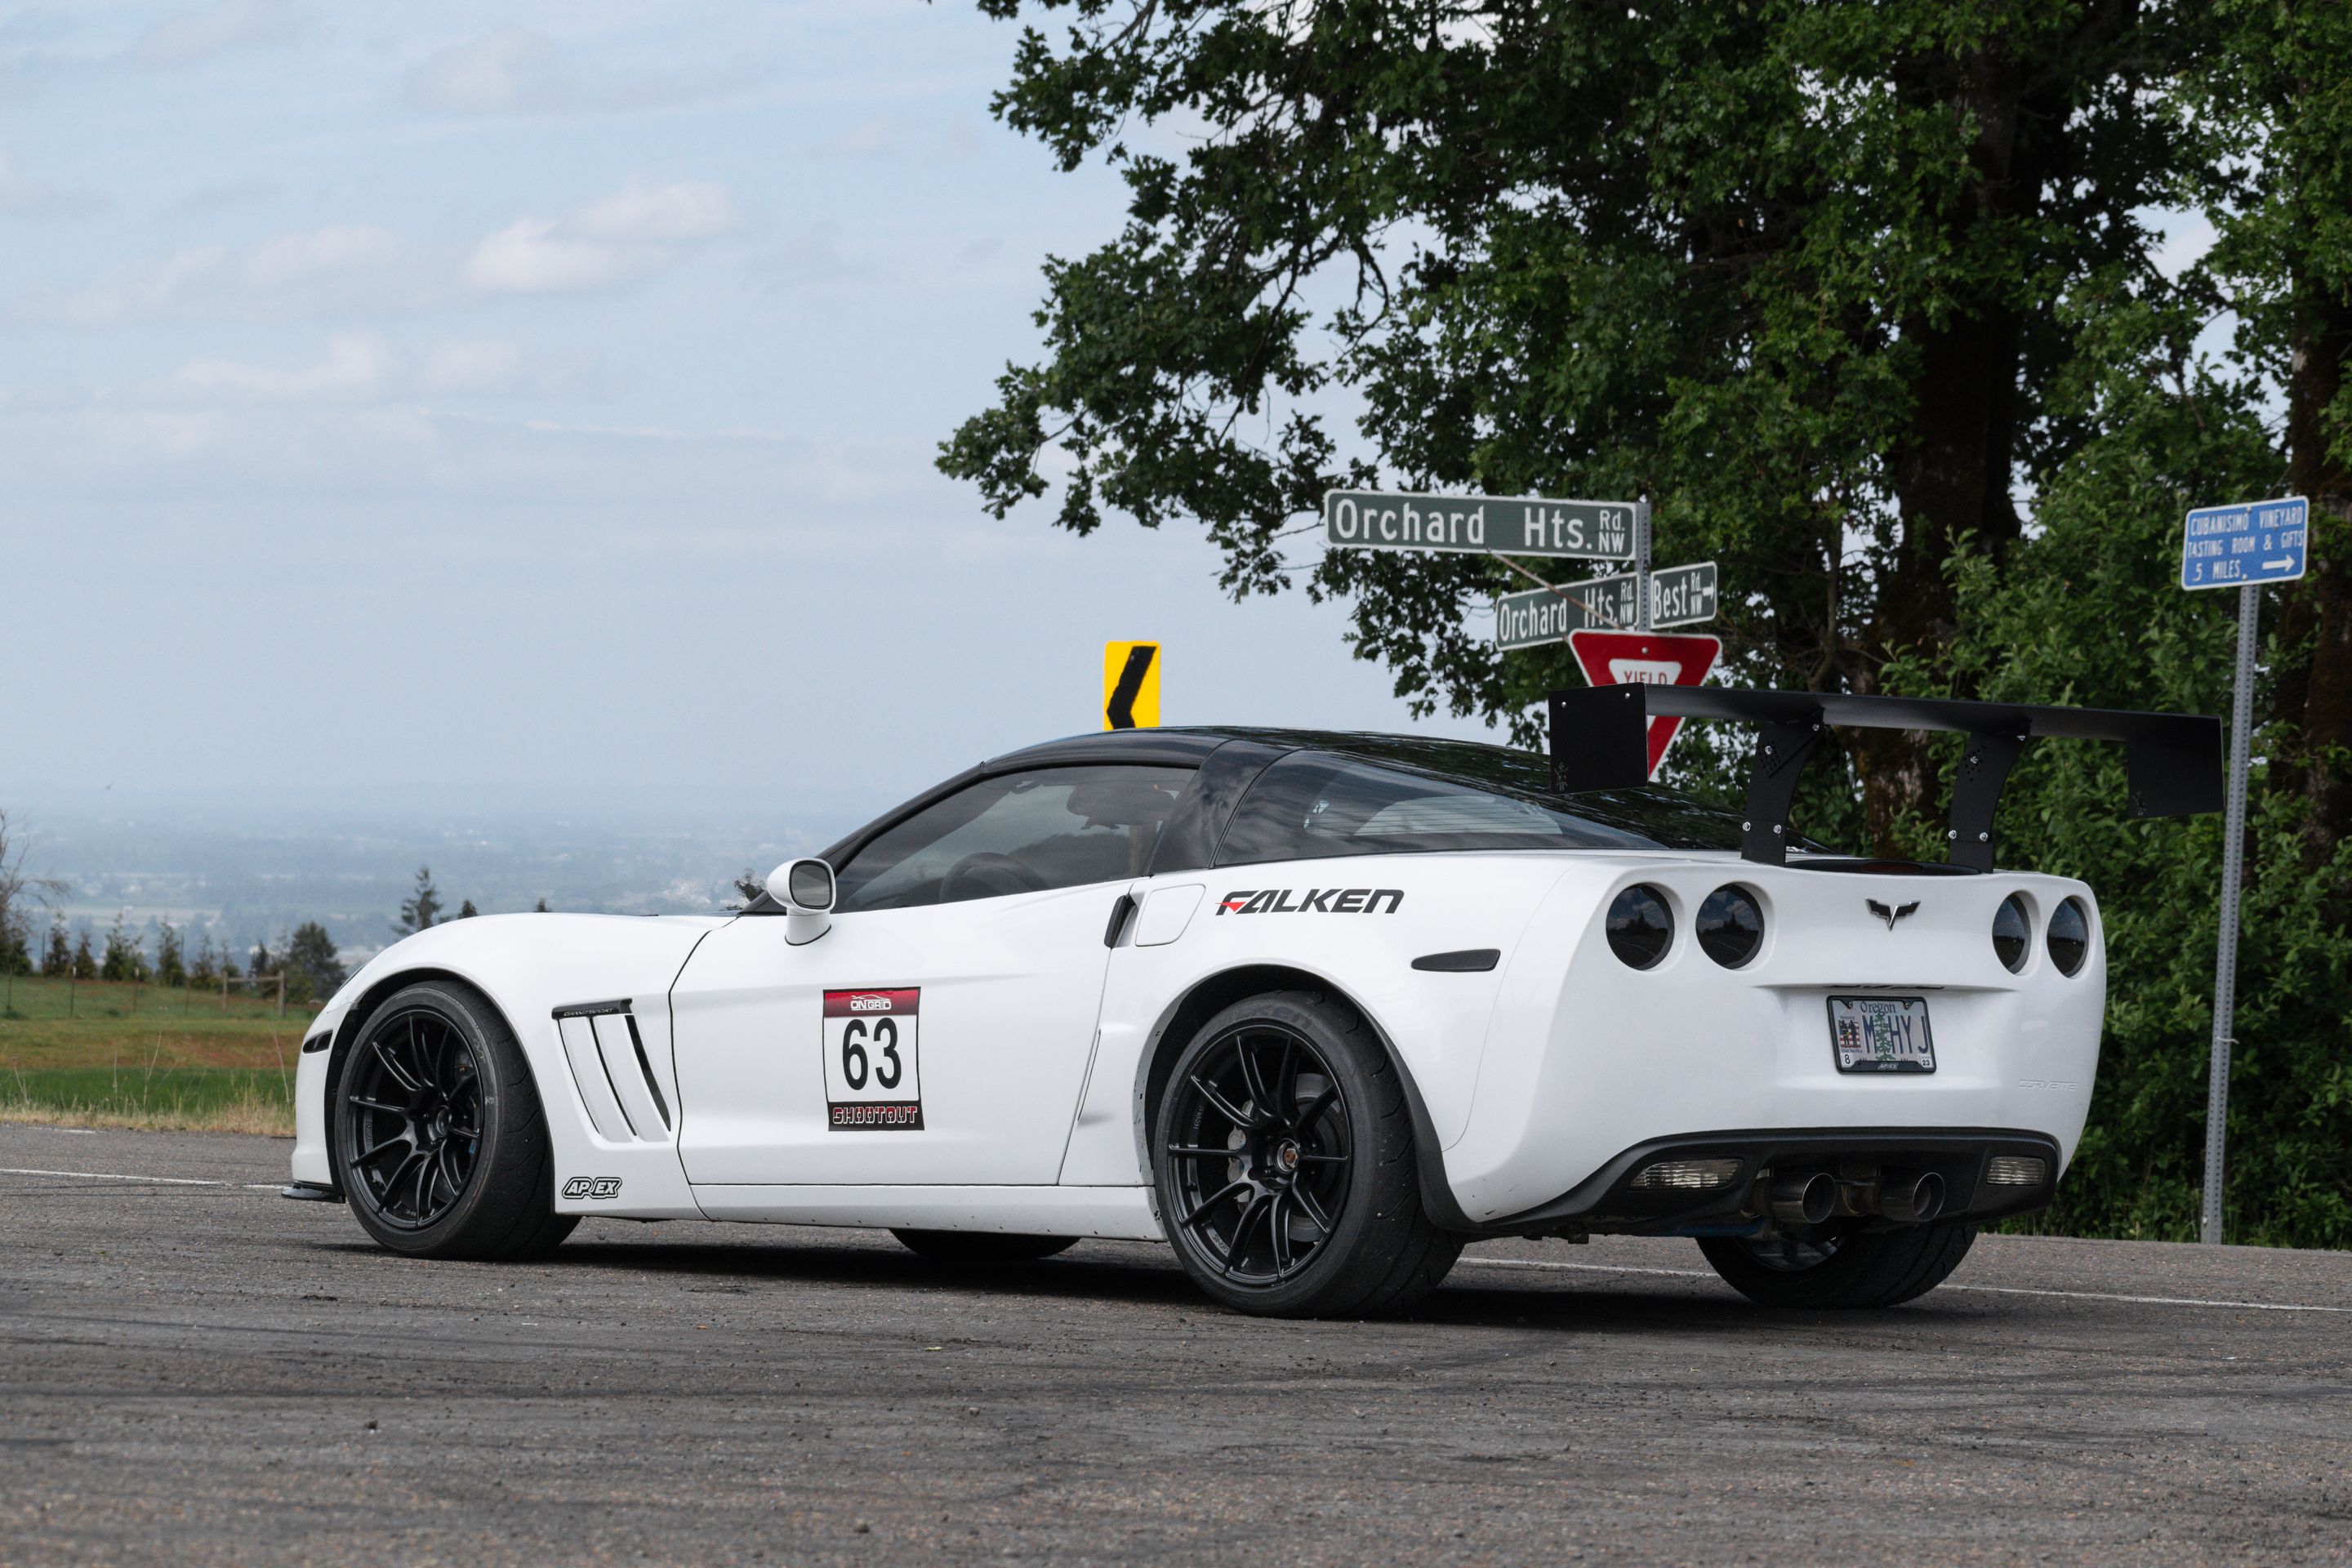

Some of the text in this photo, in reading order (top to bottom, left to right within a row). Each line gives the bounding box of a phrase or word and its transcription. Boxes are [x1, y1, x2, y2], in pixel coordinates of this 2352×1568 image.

[1336, 499, 1625, 550] Orchard Hts. Rd.
[2190, 506, 2304, 536] CUBANISIMO VINEYARD
[1598, 532, 1625, 553] NW
[2188, 530, 2304, 559] TASTING ROOM & GIFTS
[2192, 559, 2241, 581] 5 MILES
[1654, 576, 1688, 620] Best
[1690, 594, 1703, 617] NW
[1500, 598, 1567, 642] Orchard
[1584, 587, 1618, 629] Hts.
[1619, 603, 1633, 624] NW
[1215, 889, 1405, 915] FALKEN
[1860, 1000, 1896, 1016] Oregon
[842, 1017, 902, 1090] 63
[1844, 1054, 1851, 1064] 8
[833, 1106, 917, 1124] SHOOTOUT
